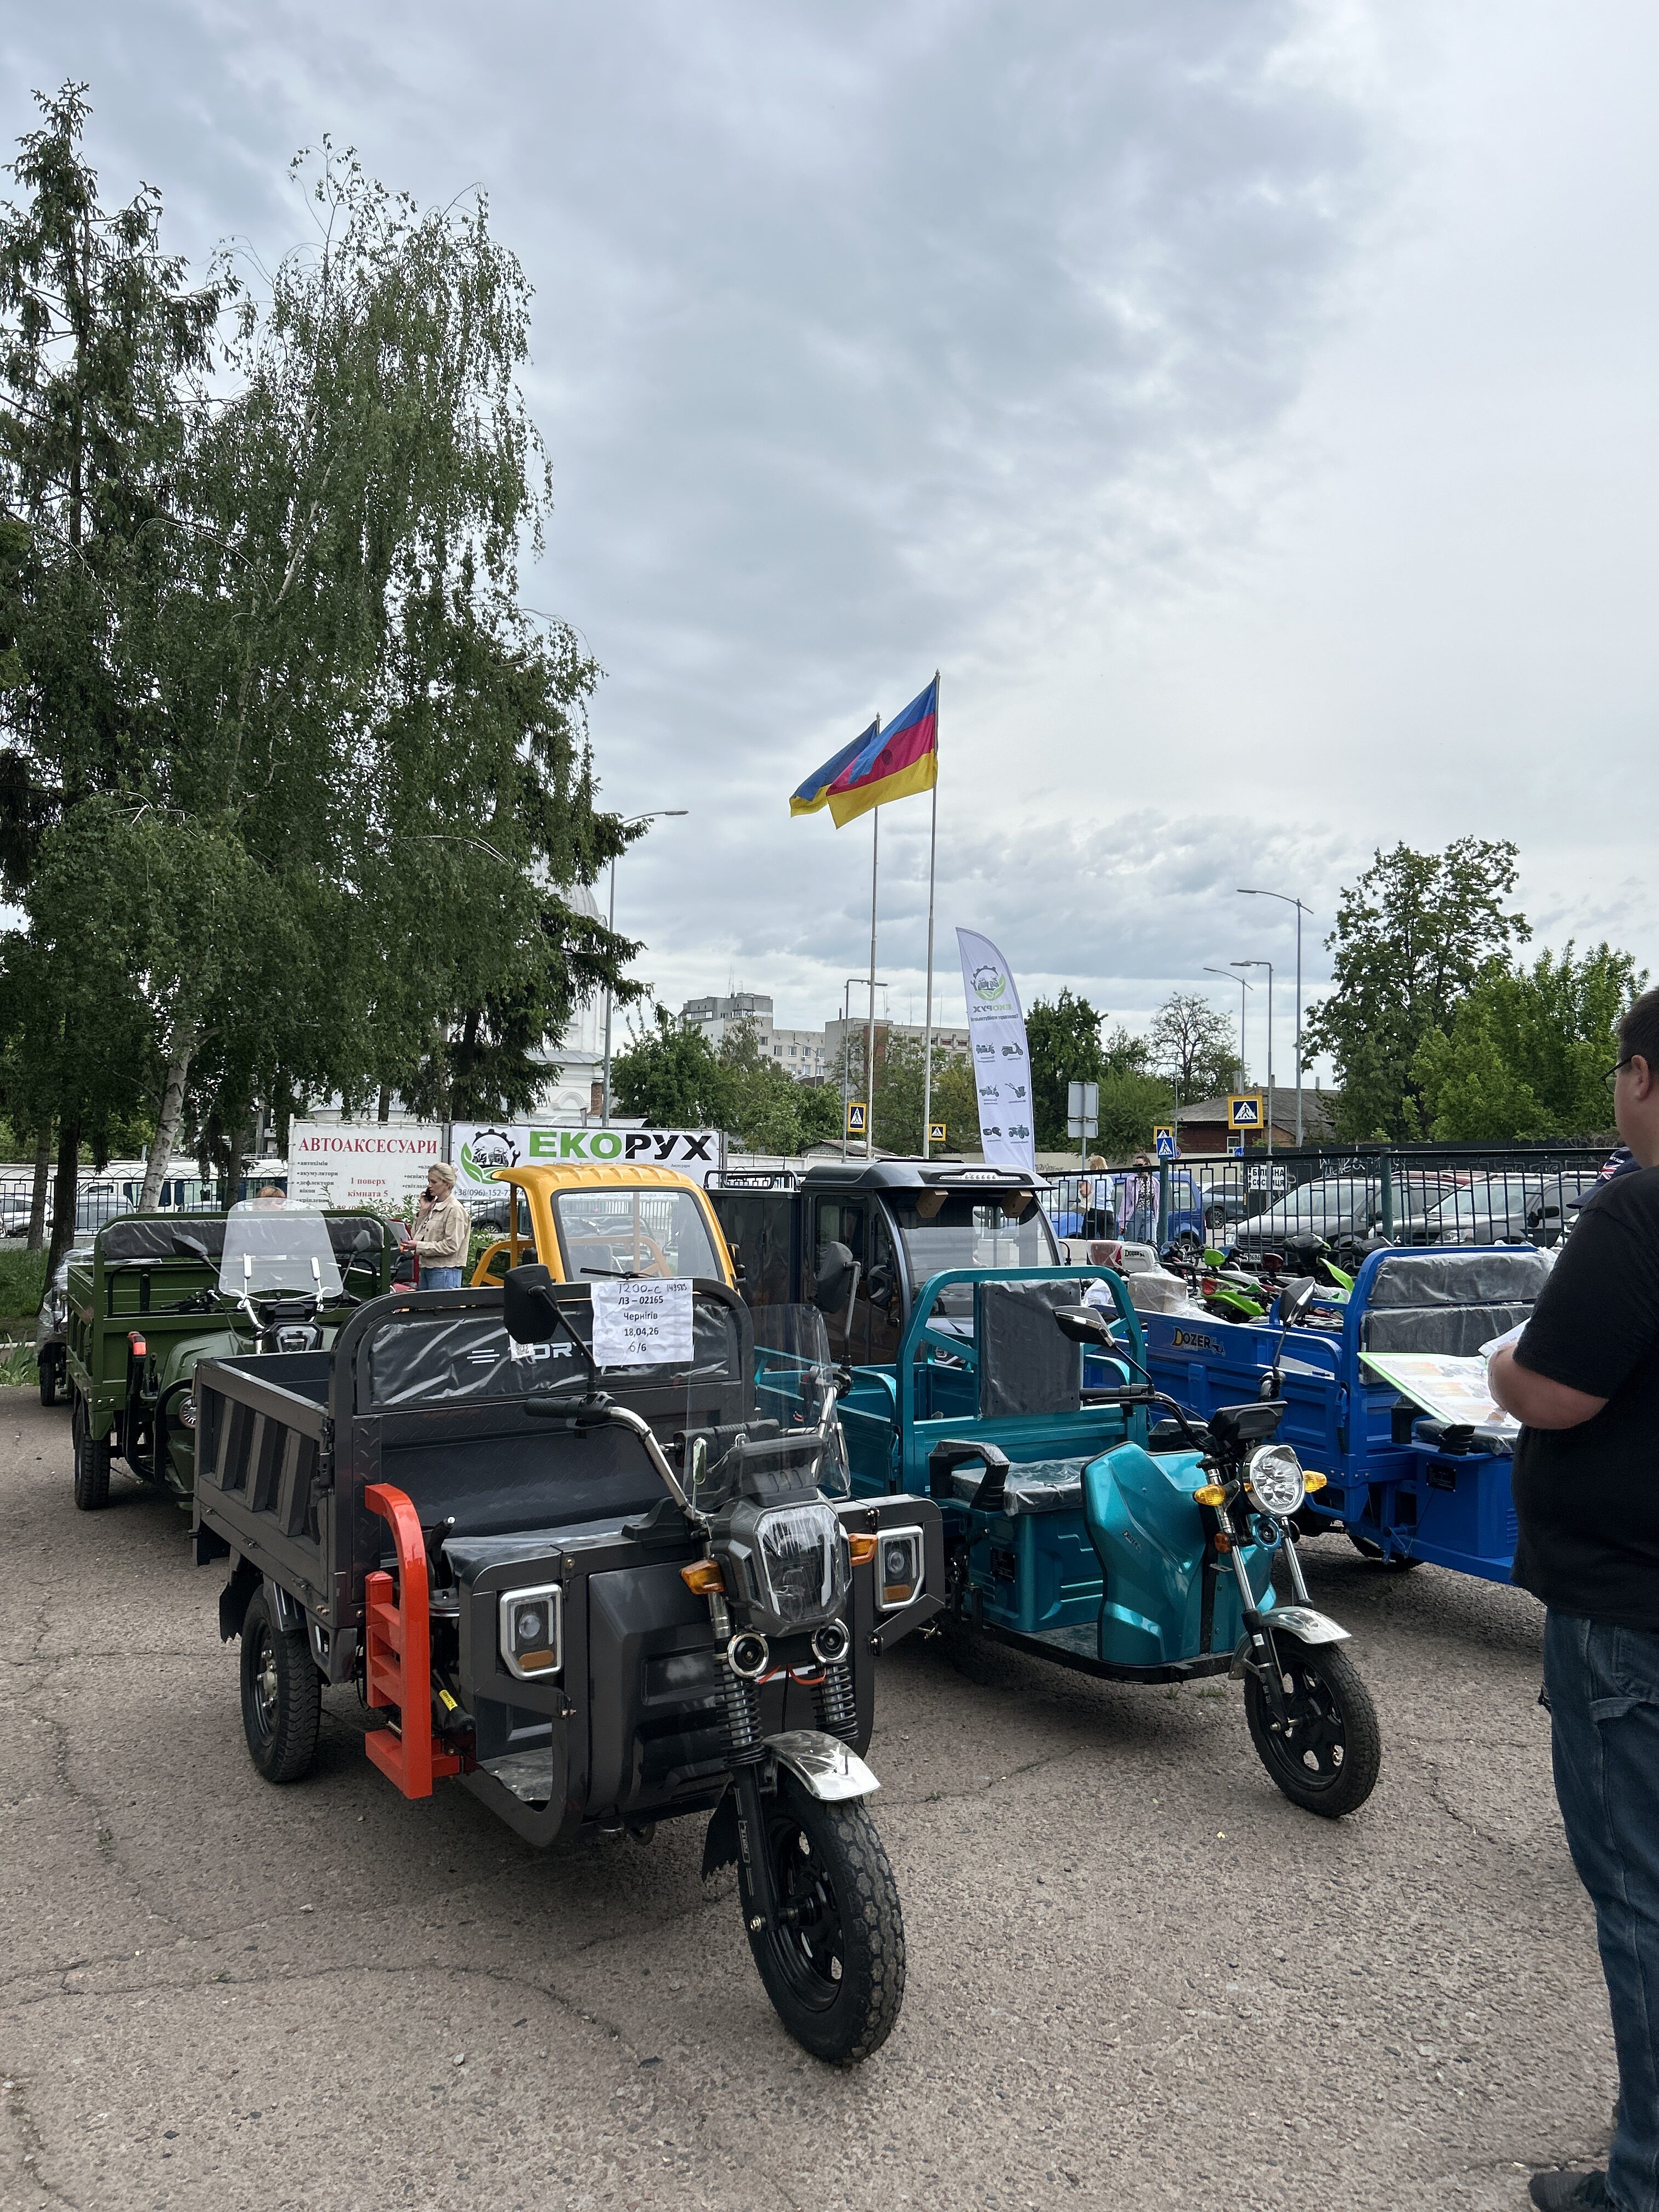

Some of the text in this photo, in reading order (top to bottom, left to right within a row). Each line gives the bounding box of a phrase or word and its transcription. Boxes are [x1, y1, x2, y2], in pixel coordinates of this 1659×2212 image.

[298, 1138, 438, 1154] АВТОАКСЕСУАРИ
[529, 1131, 712, 1161] ЕКОРУХ
[639, 1296, 663, 1305] 02165
[624, 1312, 658, 1322] Чернігів
[624, 1327, 659, 1337] 18,04,26
[1172, 1327, 1211, 1349] DOZER
[628, 1341, 647, 1353] 6/6
